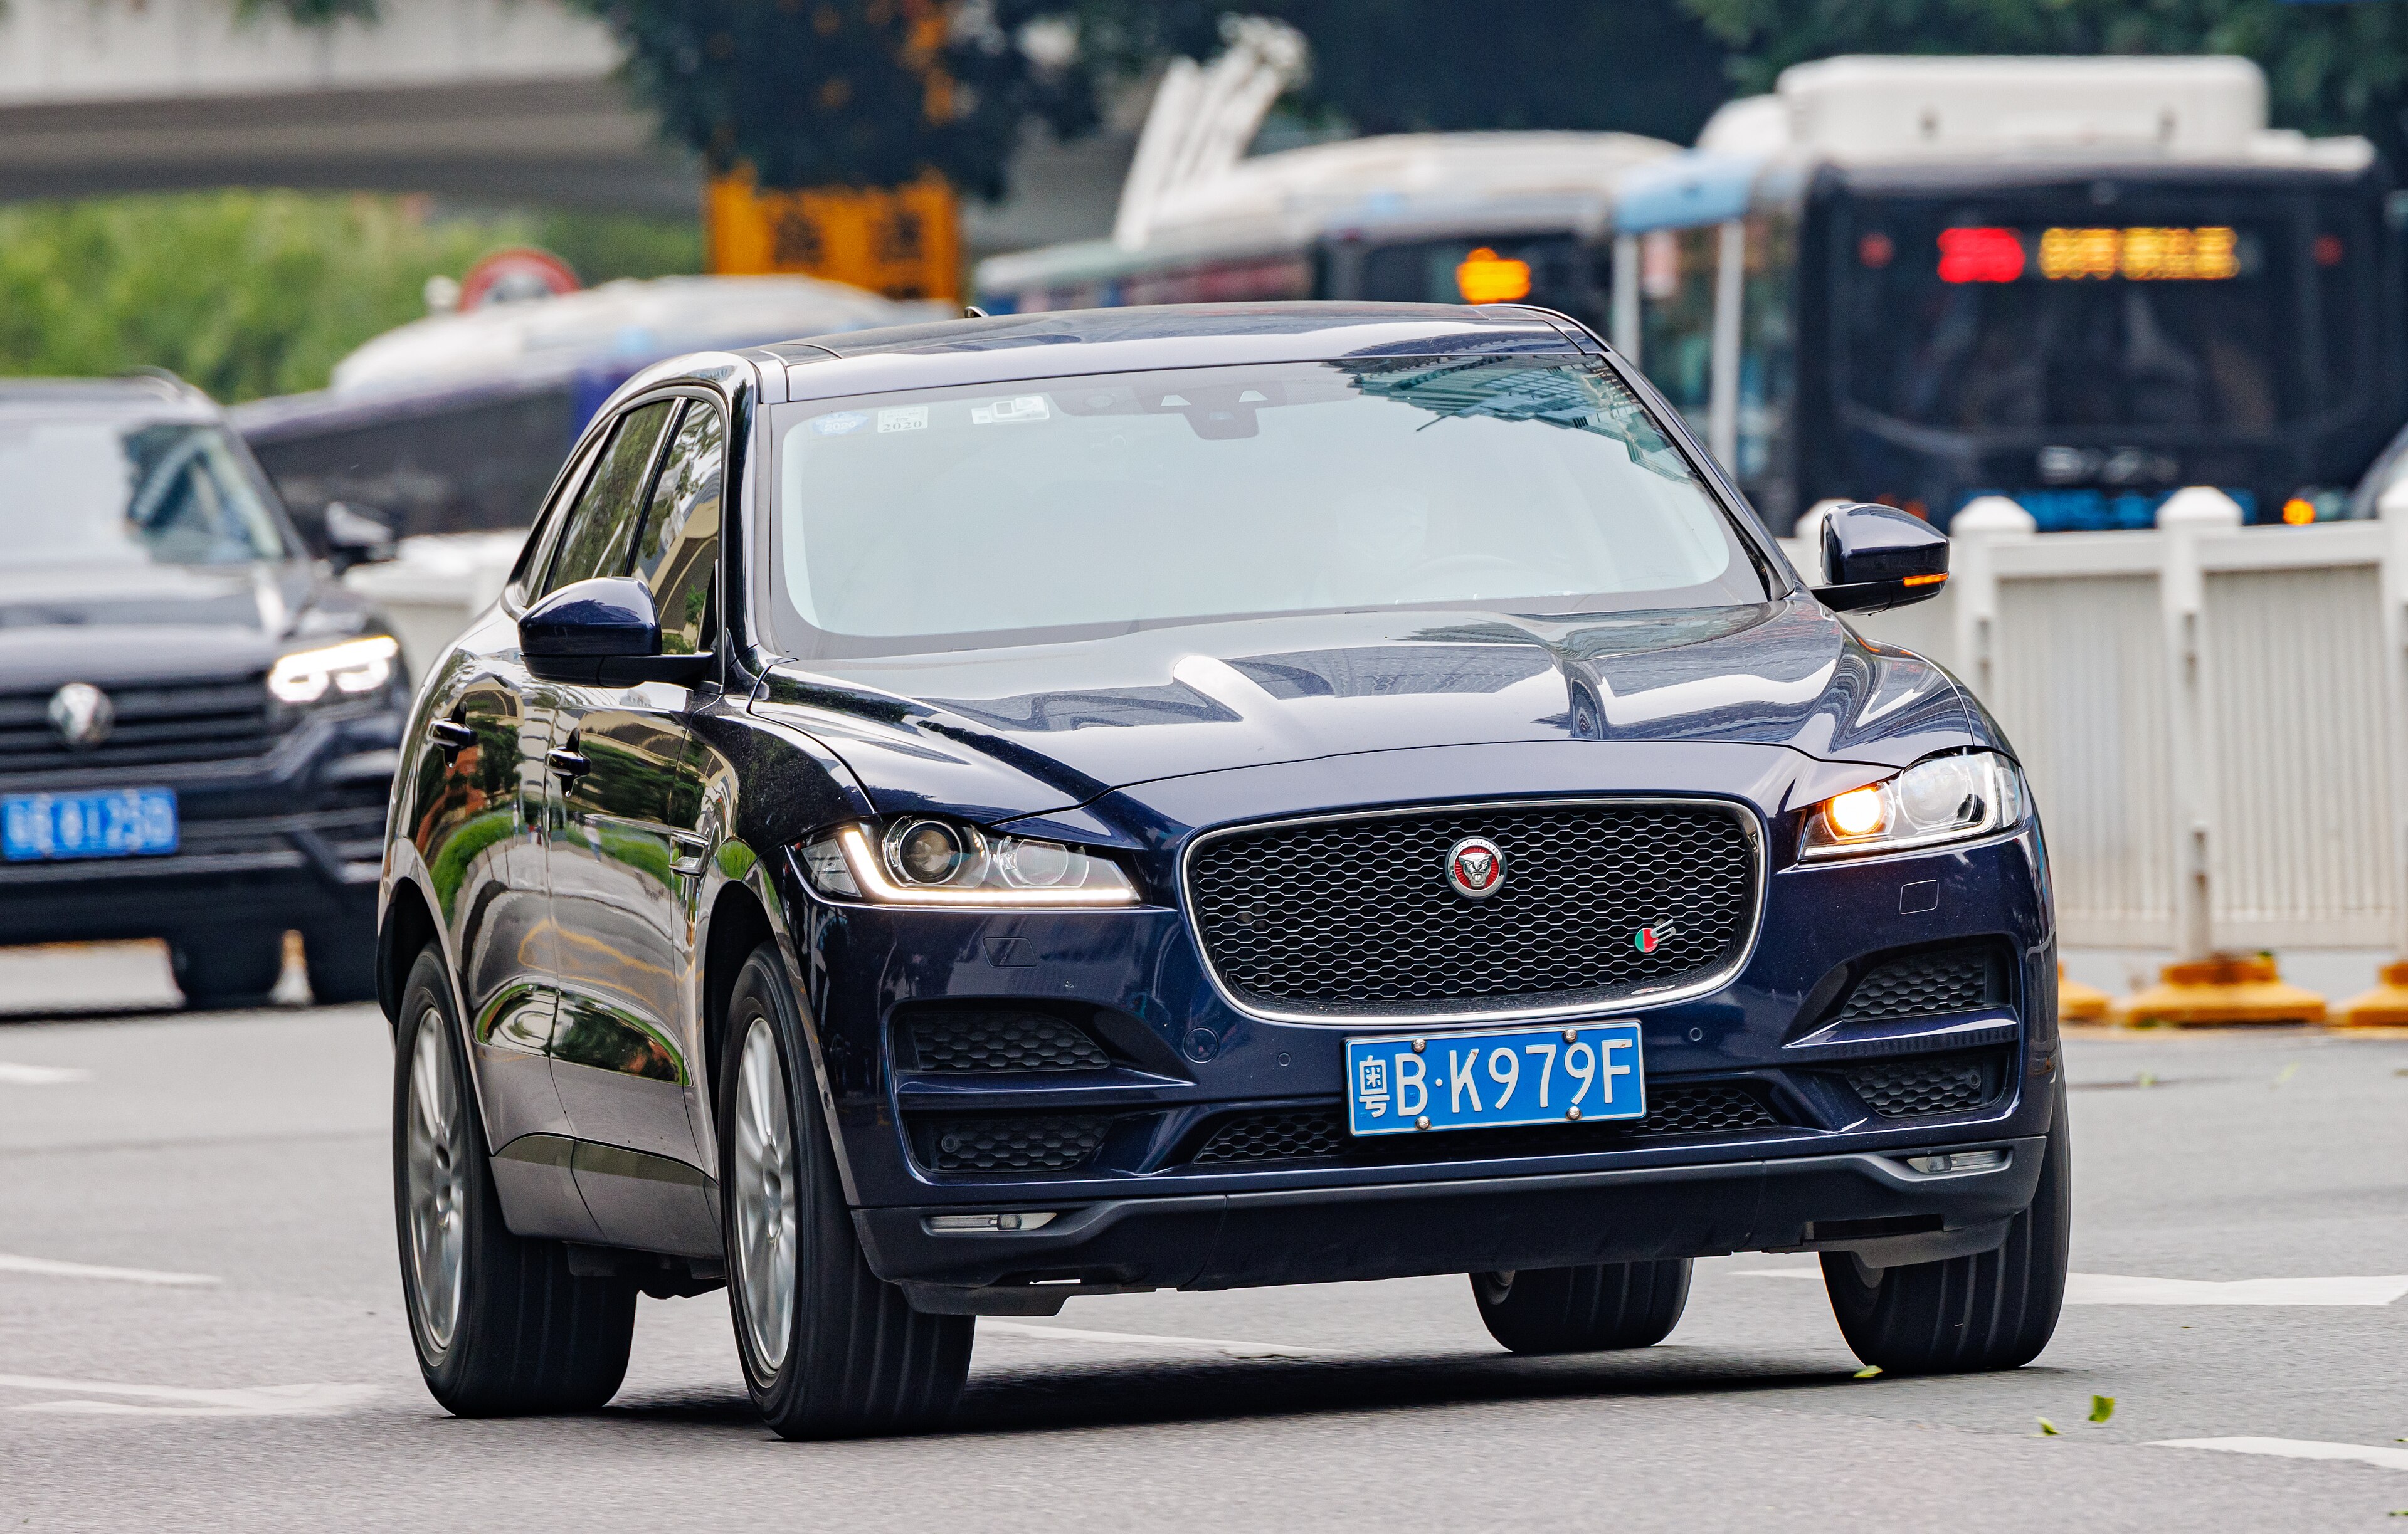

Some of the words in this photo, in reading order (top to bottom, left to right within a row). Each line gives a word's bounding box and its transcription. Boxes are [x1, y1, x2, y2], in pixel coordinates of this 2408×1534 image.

[825, 421, 857, 432] 2020
[883, 421, 922, 431] 2020
[1454, 840, 1499, 856] JAGUAR
